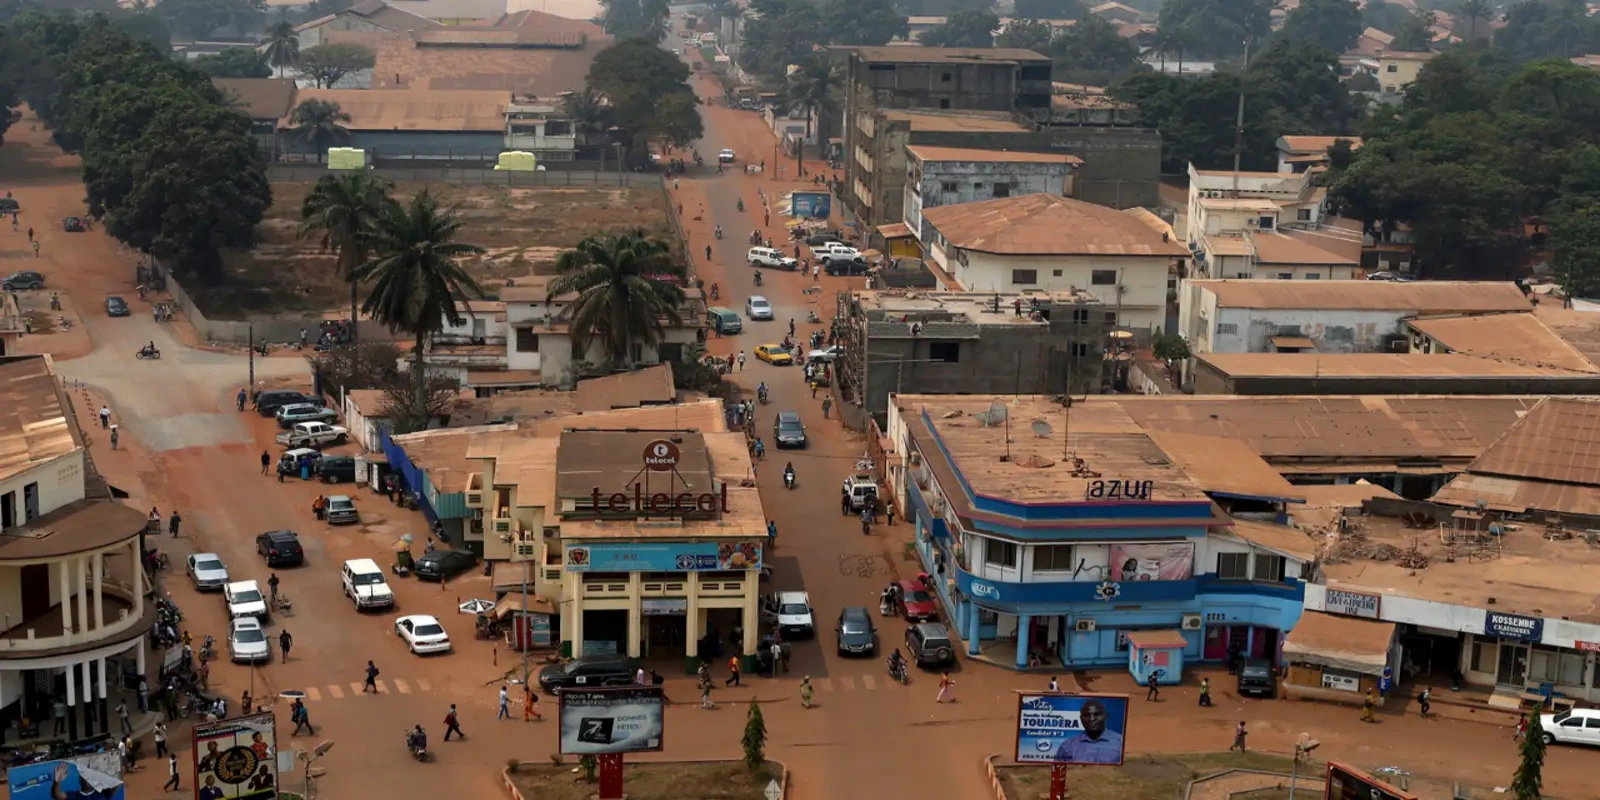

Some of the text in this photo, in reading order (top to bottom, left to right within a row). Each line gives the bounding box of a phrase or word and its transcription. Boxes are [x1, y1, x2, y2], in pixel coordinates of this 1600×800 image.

[646, 456, 675, 464] telecel
[1090, 480, 1153, 499] azur
[590, 482, 729, 513] telecel
[974, 582, 995, 594] azur
[1492, 615, 1535, 629] KOSSEMBE
